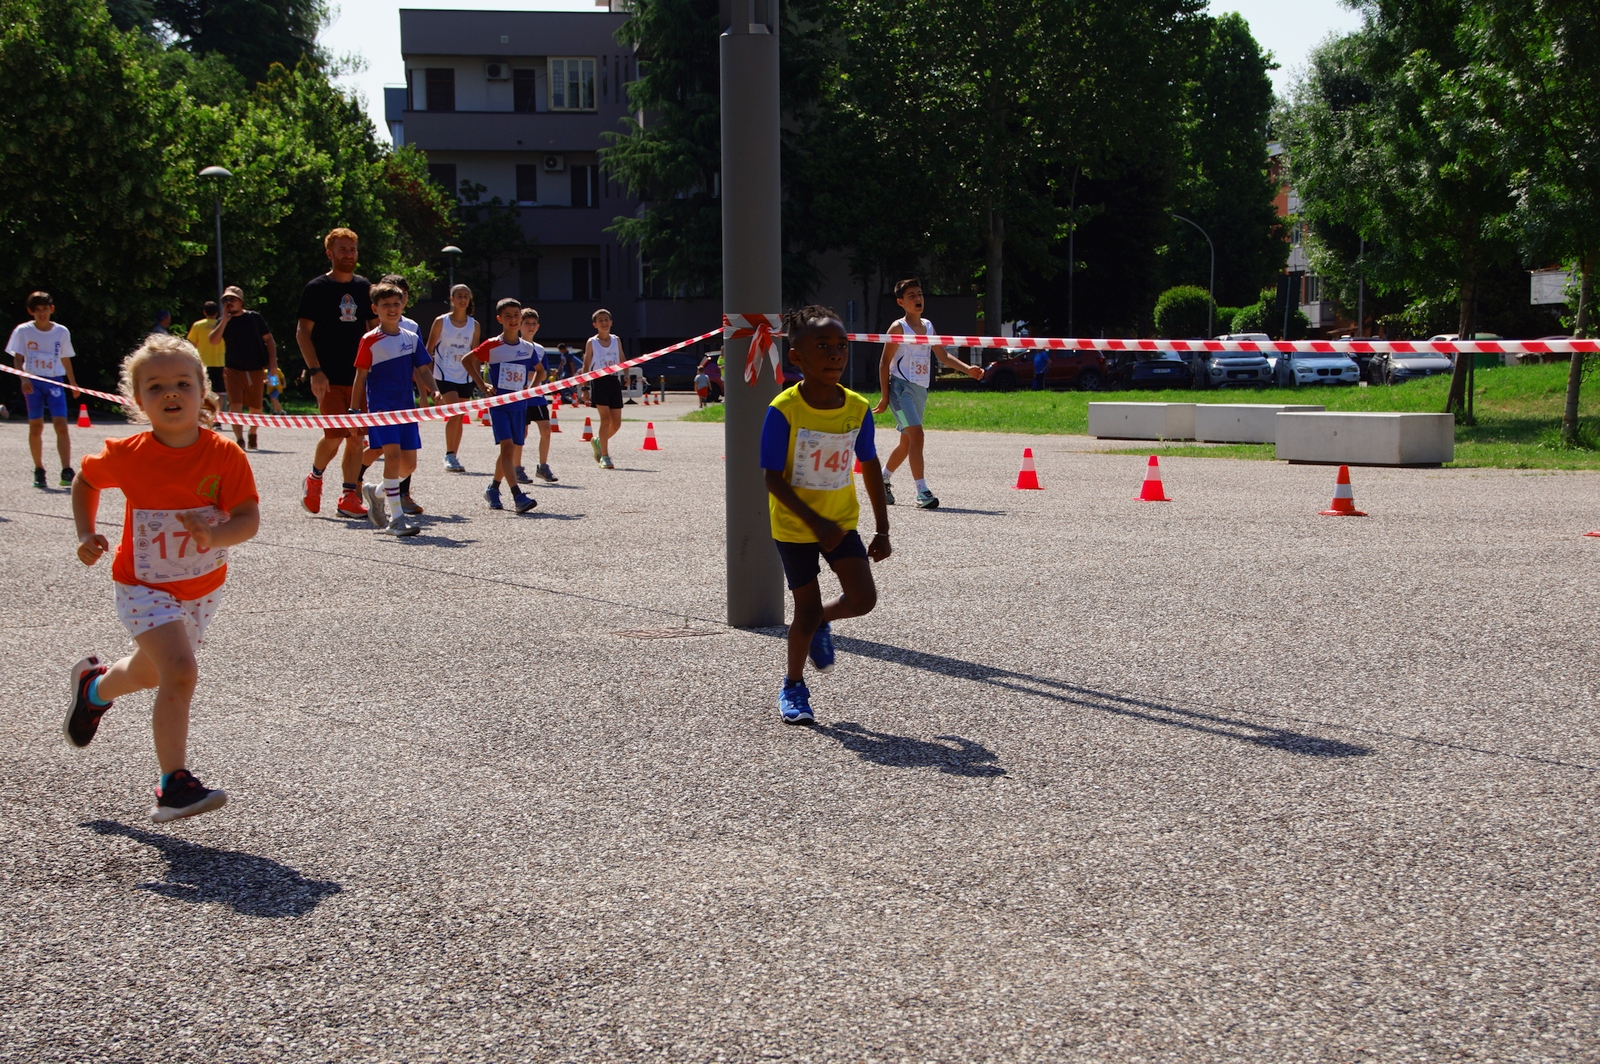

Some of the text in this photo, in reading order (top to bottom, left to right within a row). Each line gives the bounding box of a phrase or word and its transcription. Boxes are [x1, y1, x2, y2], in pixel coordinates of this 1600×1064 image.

[34, 360, 53, 370] 114
[506, 371, 523, 382] 384
[810, 449, 850, 472] 149
[152, 530, 210, 560] 17
